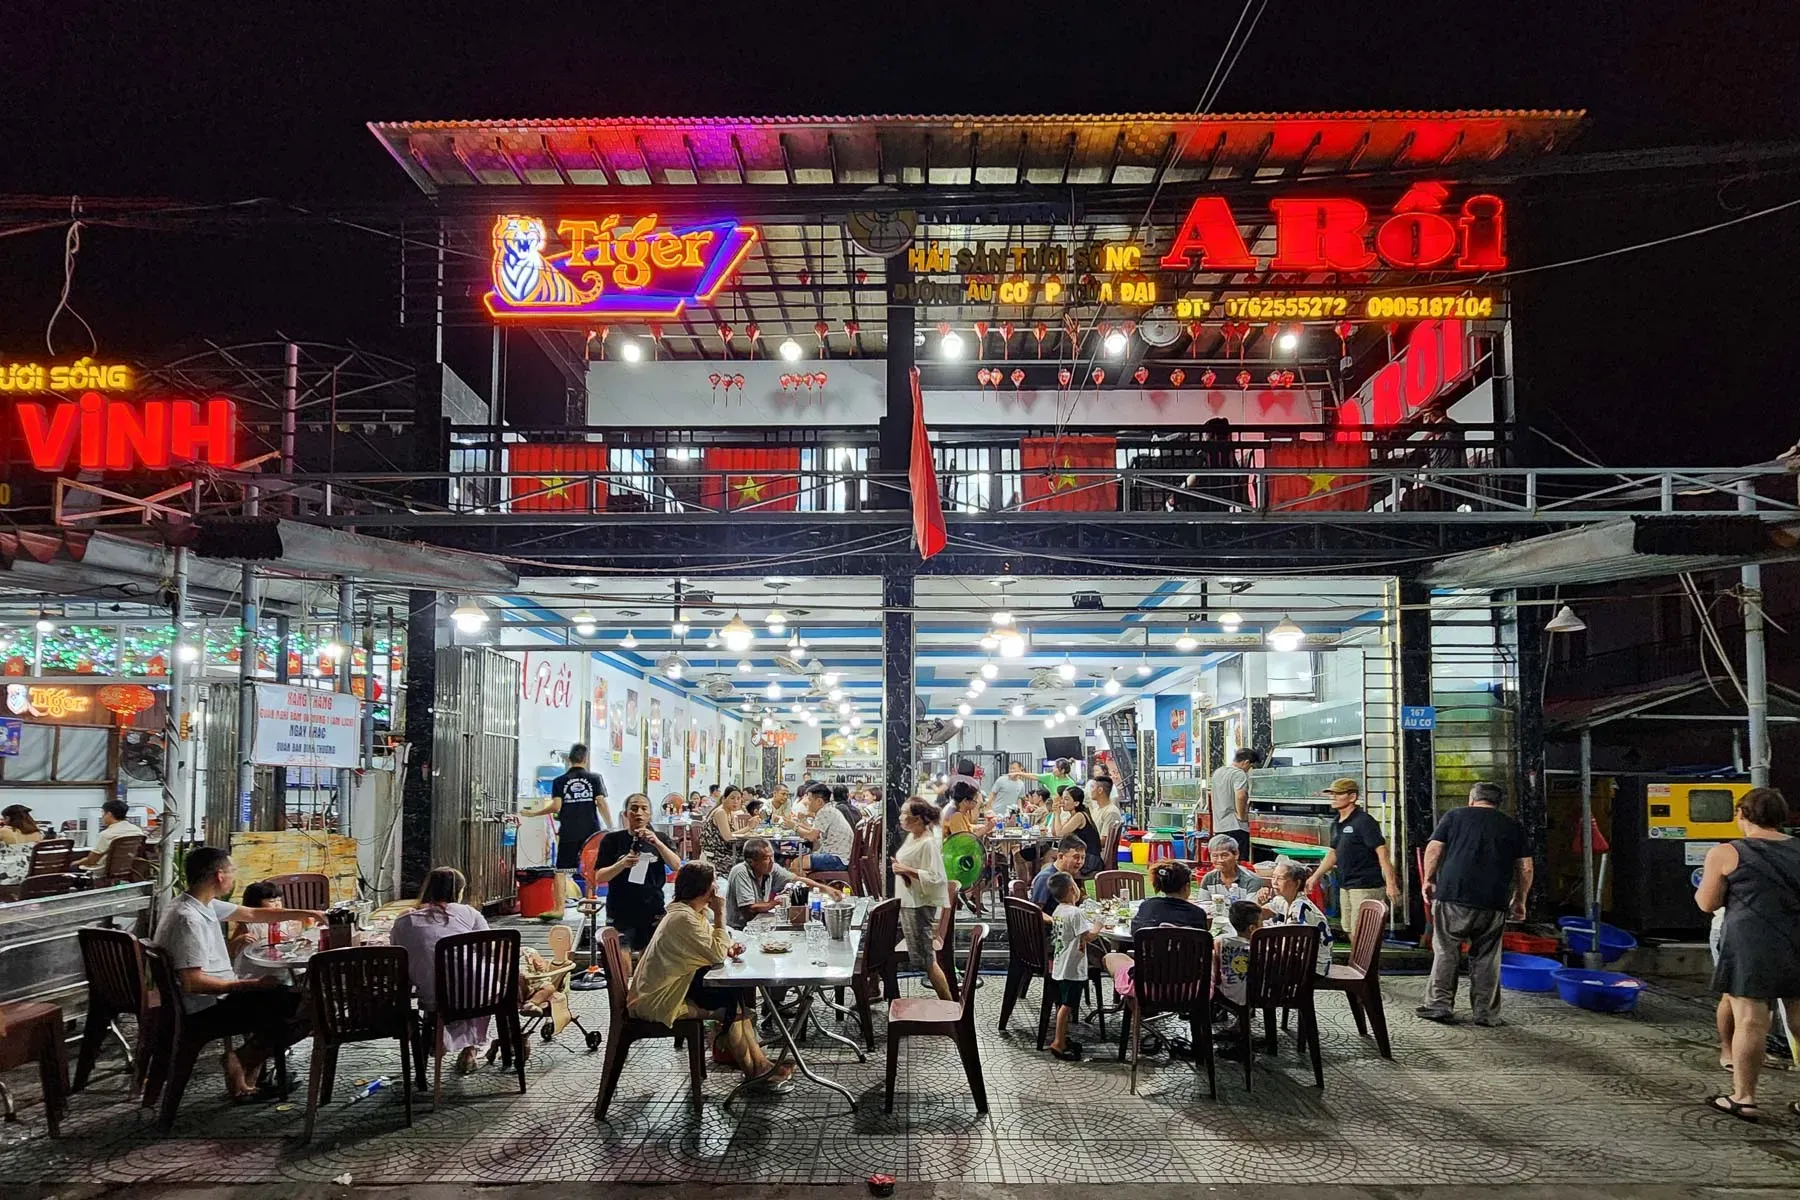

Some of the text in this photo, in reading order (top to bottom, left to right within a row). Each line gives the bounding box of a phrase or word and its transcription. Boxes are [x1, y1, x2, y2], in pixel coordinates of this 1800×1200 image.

[1160, 196, 1258, 269] A
[558, 213, 714, 289] Tiger
[908, 240, 950, 272] HẢI
[967, 279, 993, 302] ÂU
[999, 281, 1030, 303] CƠ
[1121, 281, 1156, 304] ĐẠI
[1225, 297, 1347, 318] 0762555272
[1368, 297, 1492, 317] 0905187104
[29, 686, 90, 717] Tiger
